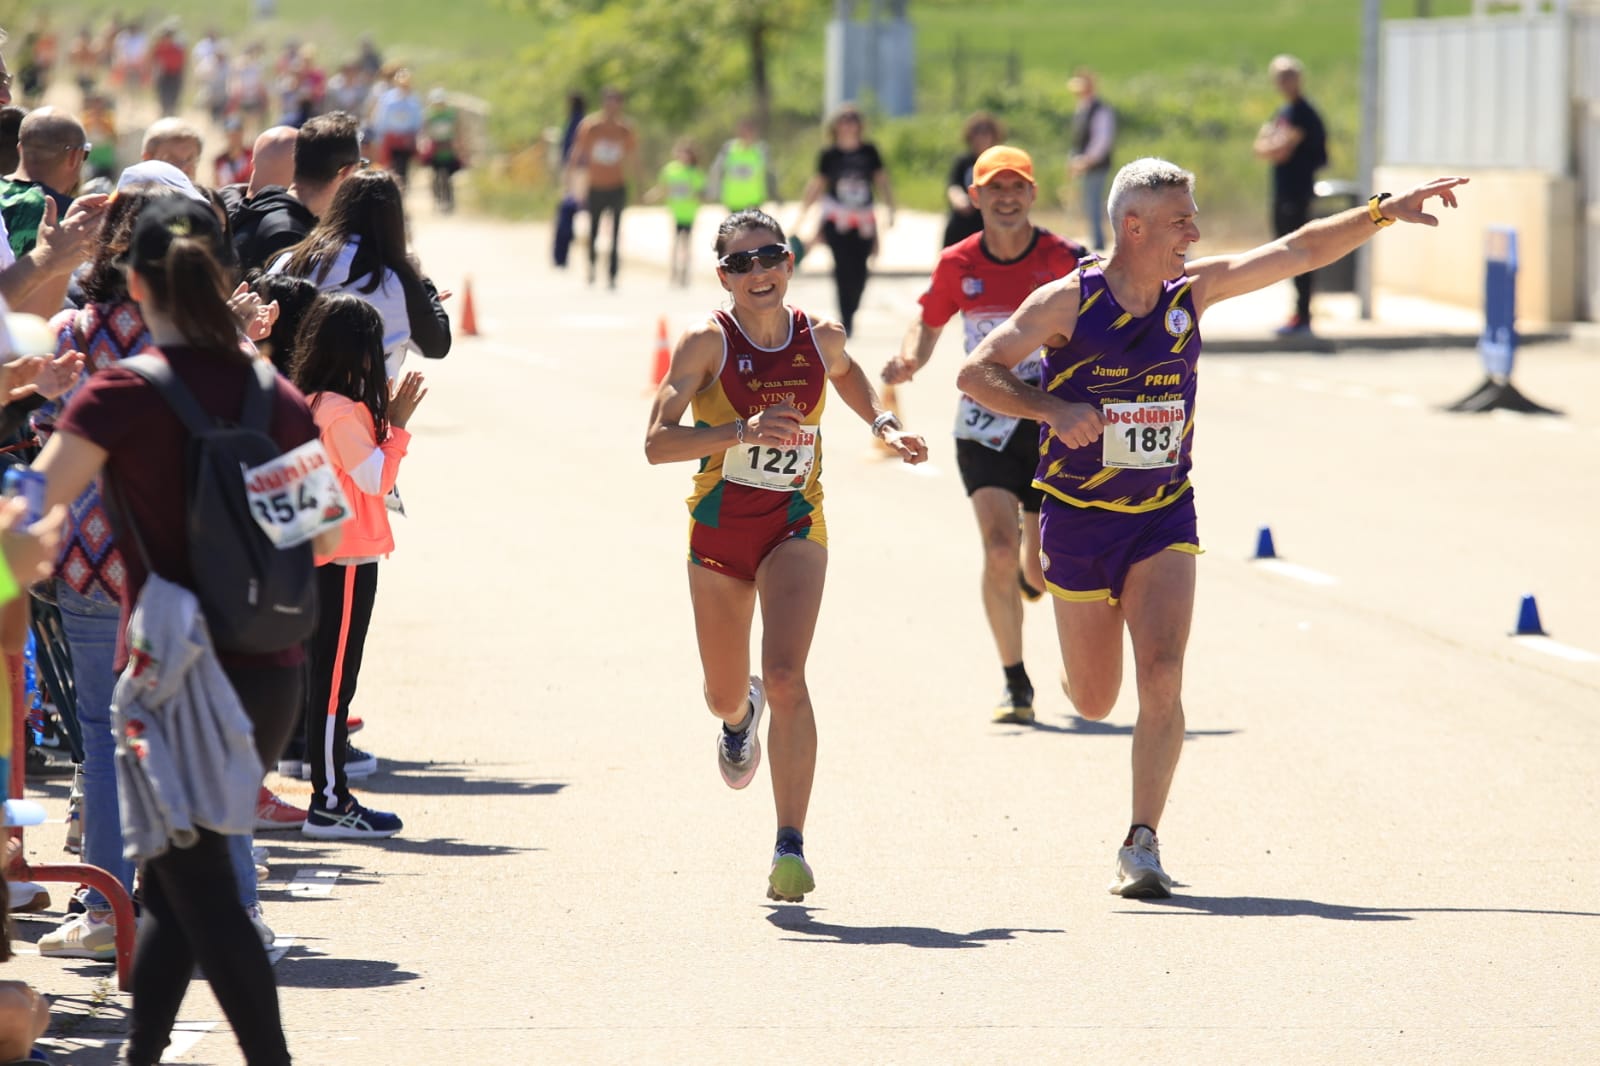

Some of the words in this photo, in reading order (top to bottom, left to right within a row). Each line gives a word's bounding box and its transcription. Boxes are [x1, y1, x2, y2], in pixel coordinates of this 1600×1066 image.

[1092, 365, 1128, 377] Jamón
[1145, 374, 1180, 387] PRIM
[761, 391, 795, 402] VINO
[966, 408, 996, 431] 37
[1106, 406, 1184, 424] bedunia
[1125, 426, 1171, 453] 183
[748, 445, 798, 474] 122
